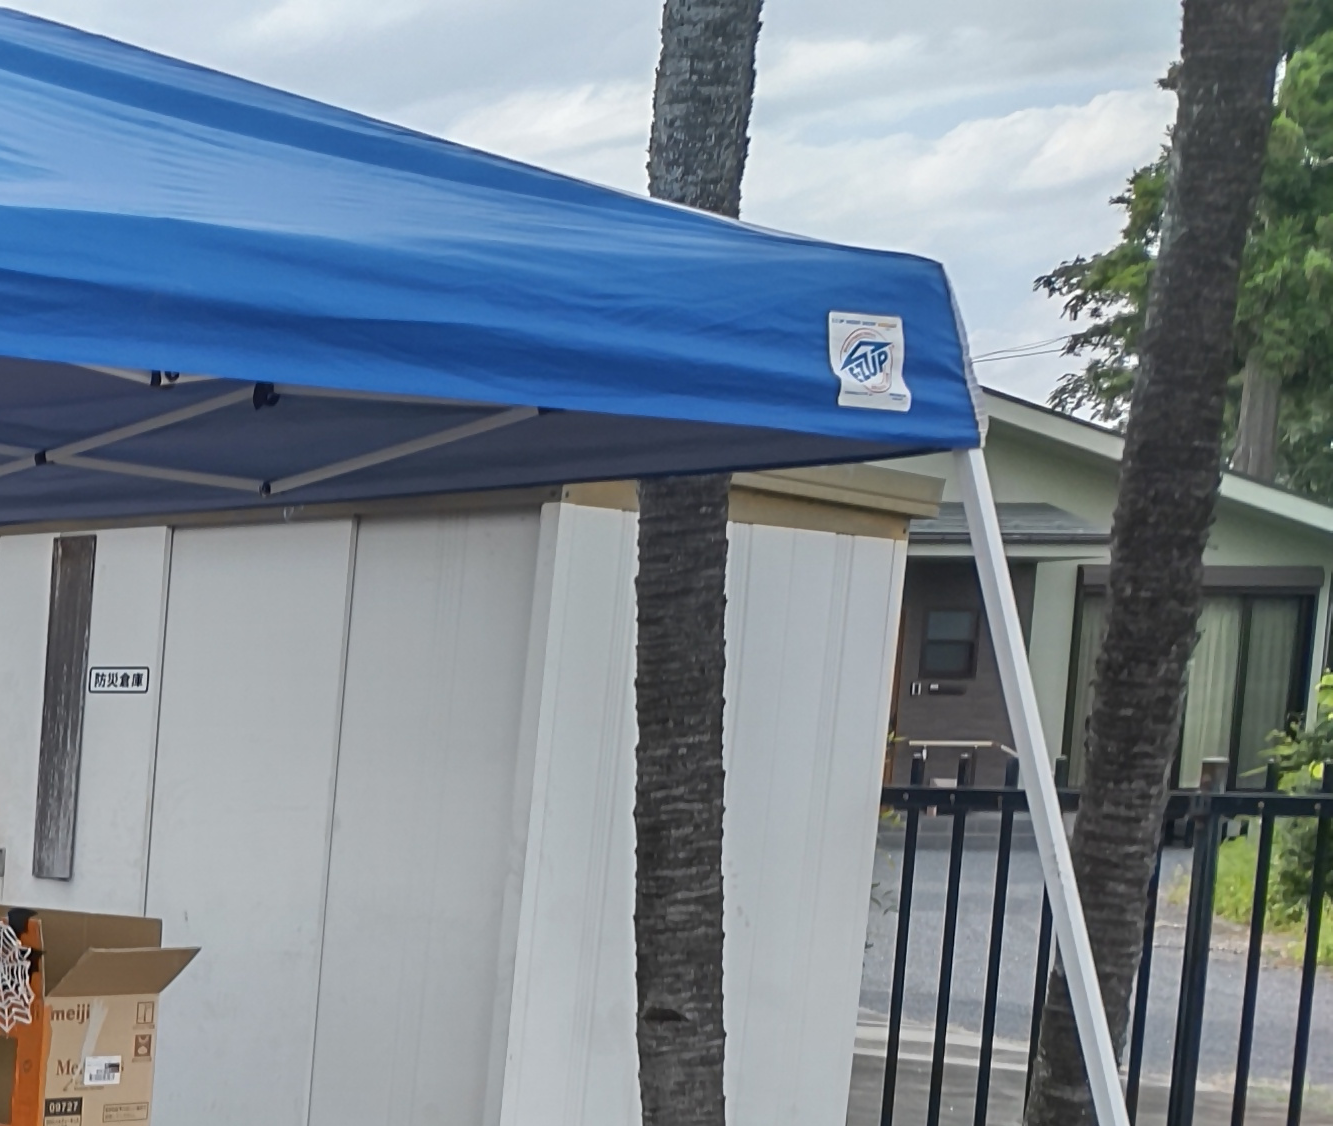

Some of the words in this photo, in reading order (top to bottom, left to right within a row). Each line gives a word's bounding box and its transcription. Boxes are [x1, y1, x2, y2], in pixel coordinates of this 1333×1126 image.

[94, 671, 144, 688] 防災倉庫
[51, 1003, 91, 1025] meiji
[49, 1101, 79, 1113] 09727
